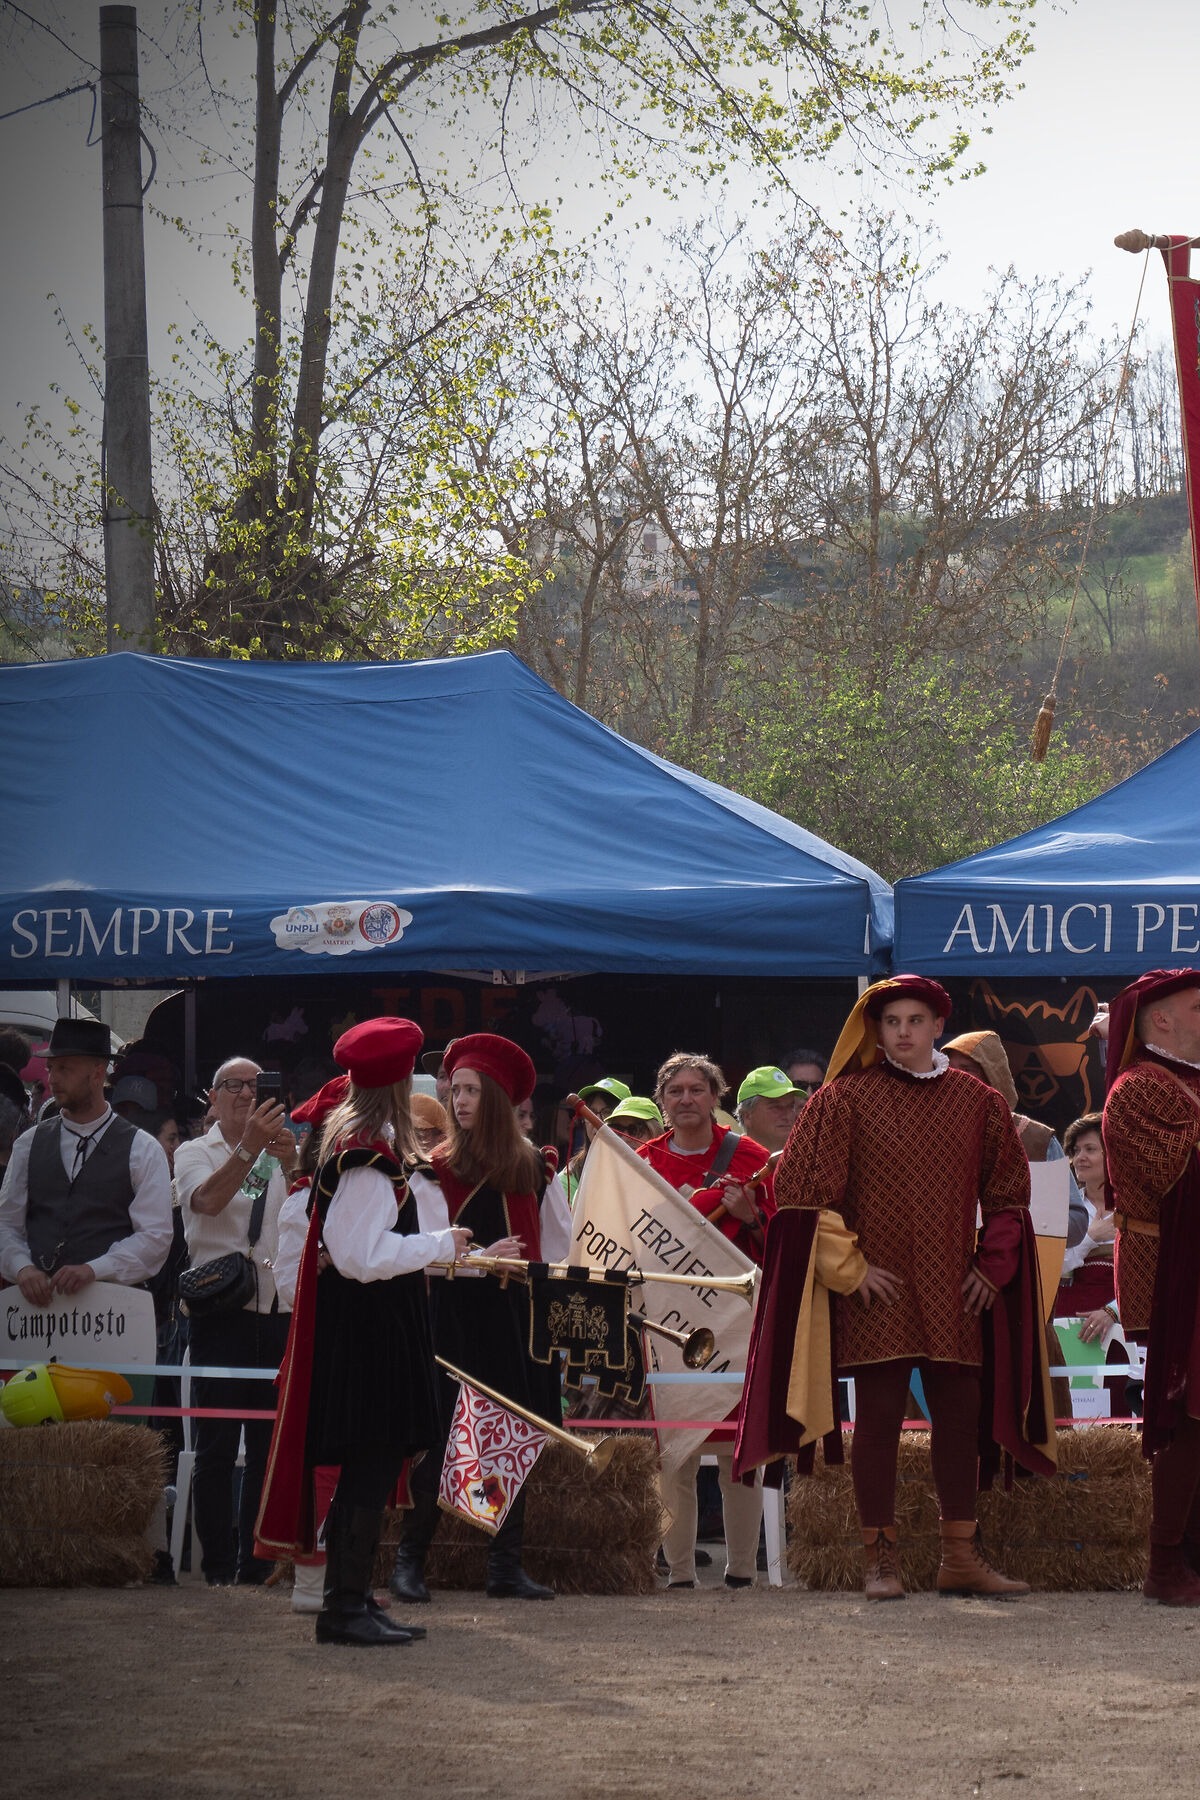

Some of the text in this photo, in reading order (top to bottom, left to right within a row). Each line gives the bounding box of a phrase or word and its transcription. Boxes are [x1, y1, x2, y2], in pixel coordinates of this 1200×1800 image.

[10, 907, 235, 959] SEMPRE
[285, 924, 319, 933] UNPLI
[942, 903, 1112, 953] AMICI
[6, 1305, 126, 1349] Campotosto
